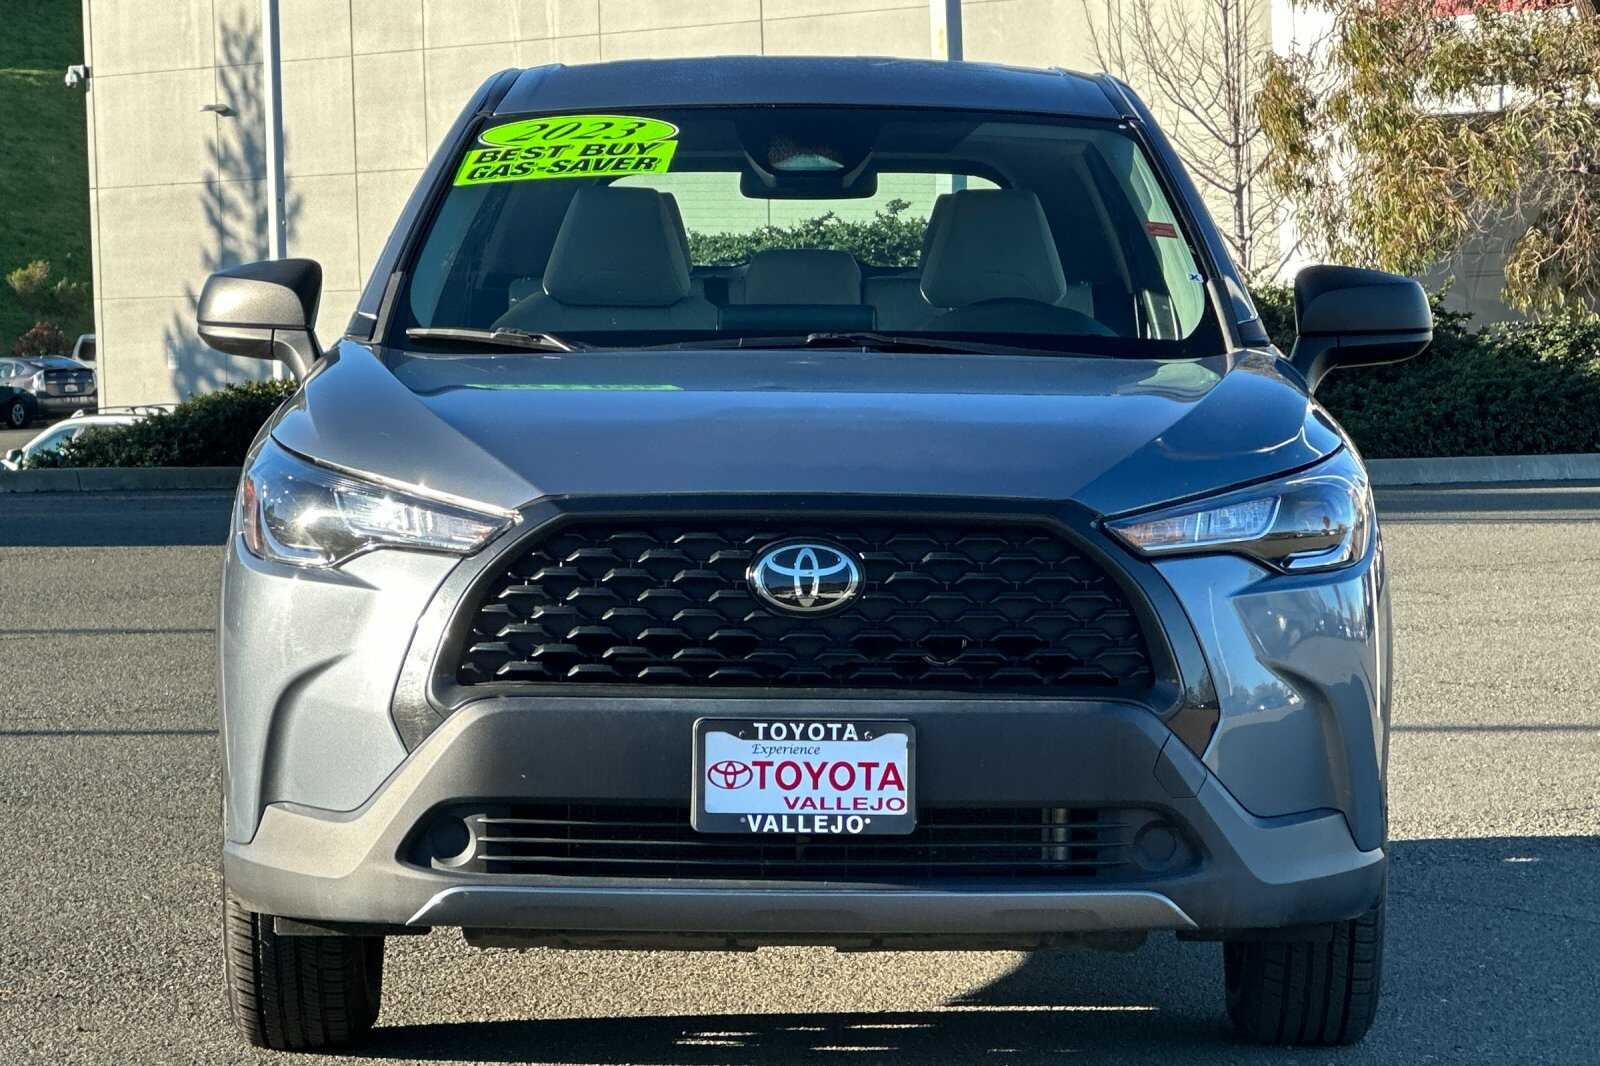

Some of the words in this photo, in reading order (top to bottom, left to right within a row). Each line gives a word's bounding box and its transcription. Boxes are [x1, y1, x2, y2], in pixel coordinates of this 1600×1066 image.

[506, 121, 648, 142] 2023
[472, 144, 573, 164] BEST
[578, 142, 664, 156] BUY
[753, 722, 858, 741] TOYOTA
[752, 743, 821, 757] Experience
[751, 761, 905, 791] TOYOTA
[783, 797, 905, 811] VALLEJO
[747, 815, 863, 833] VALLEJO
